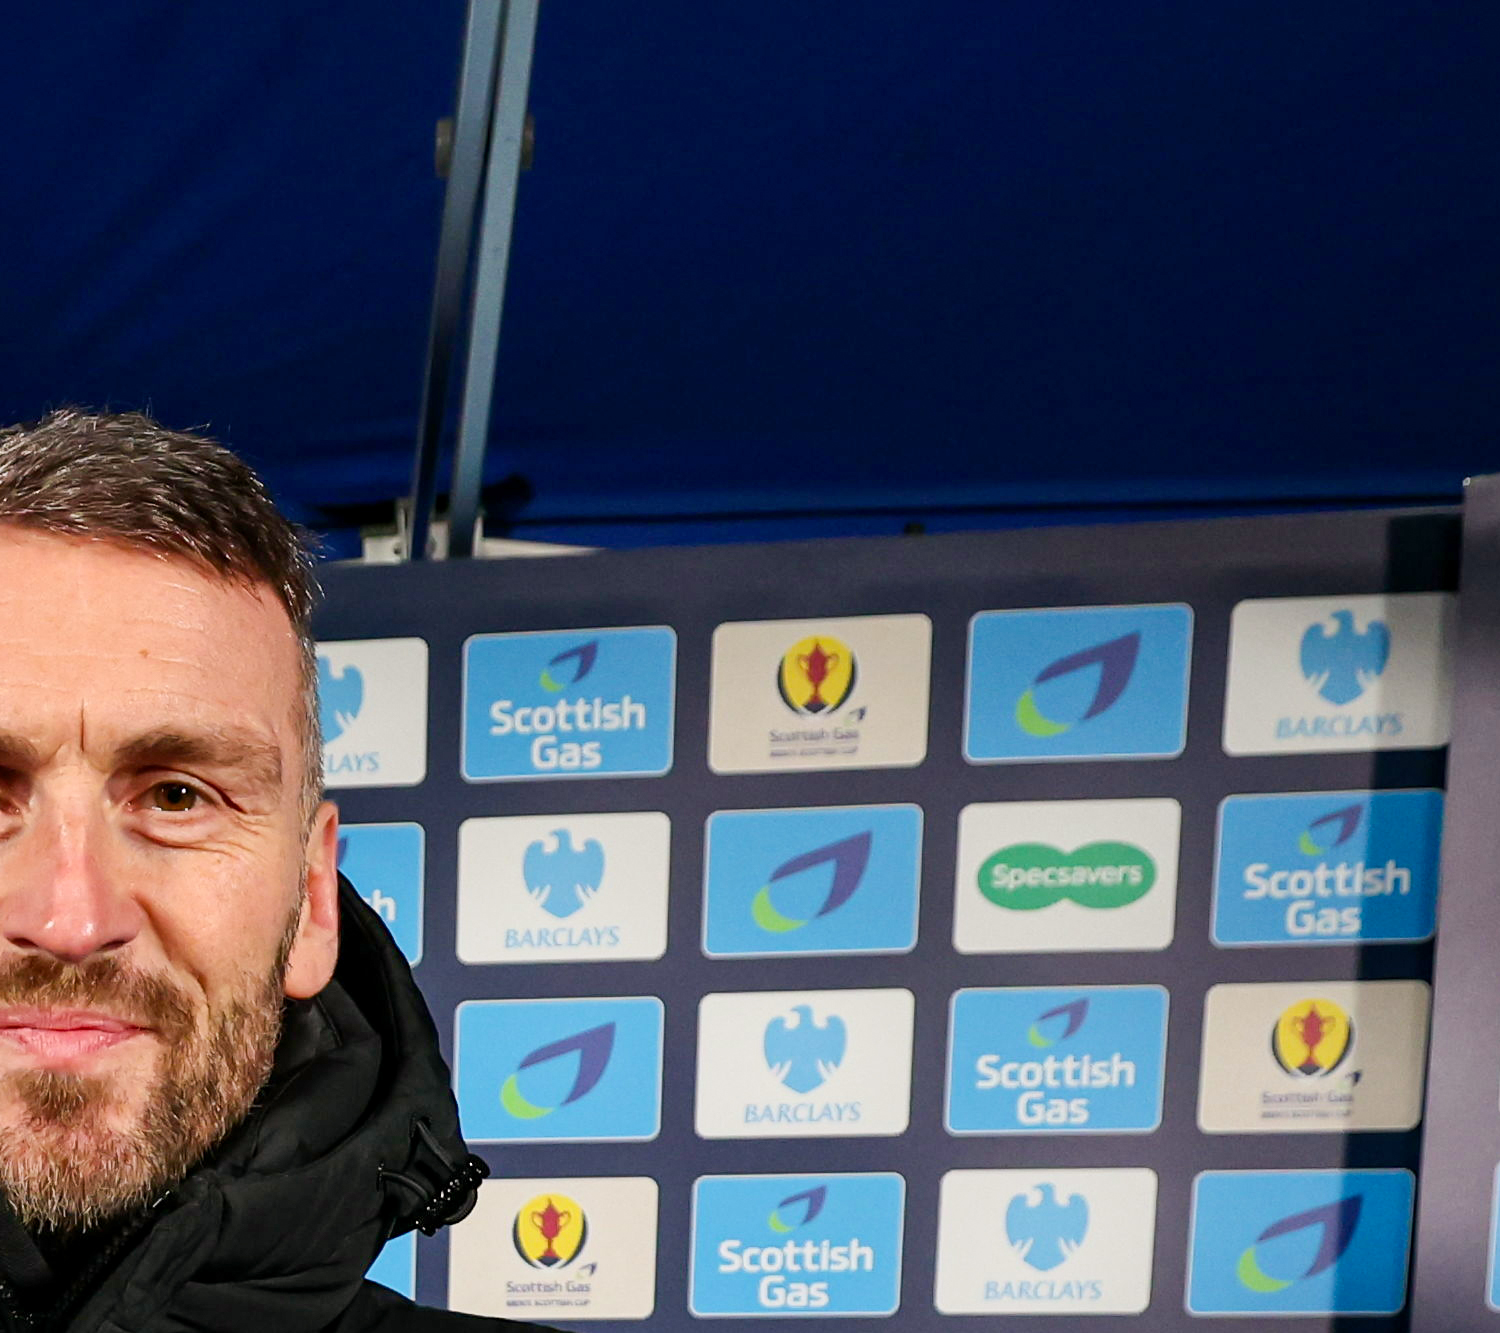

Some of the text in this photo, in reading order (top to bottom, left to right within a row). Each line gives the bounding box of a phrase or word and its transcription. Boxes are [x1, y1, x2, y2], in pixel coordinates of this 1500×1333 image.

[489, 695, 646, 736] Scottish
[1275, 711, 1404, 739] BARCLAYS
[327, 751, 380, 775] LAYS
[530, 735, 602, 769] Gas
[991, 860, 1144, 892] Specsavers
[1243, 860, 1412, 900] Scottish
[1285, 899, 1362, 936] Gas
[504, 926, 621, 949] BARCLAYS
[975, 1053, 1136, 1090] Scottish
[744, 1102, 861, 1124] BARCLAYS
[1015, 1090, 1090, 1126] Gas
[717, 1238, 874, 1274] Scottish
[505, 1280, 591, 1295] Scottish Gas
[758, 1275, 830, 1309] Gas
[984, 1280, 1103, 1302] BARCLAYS
